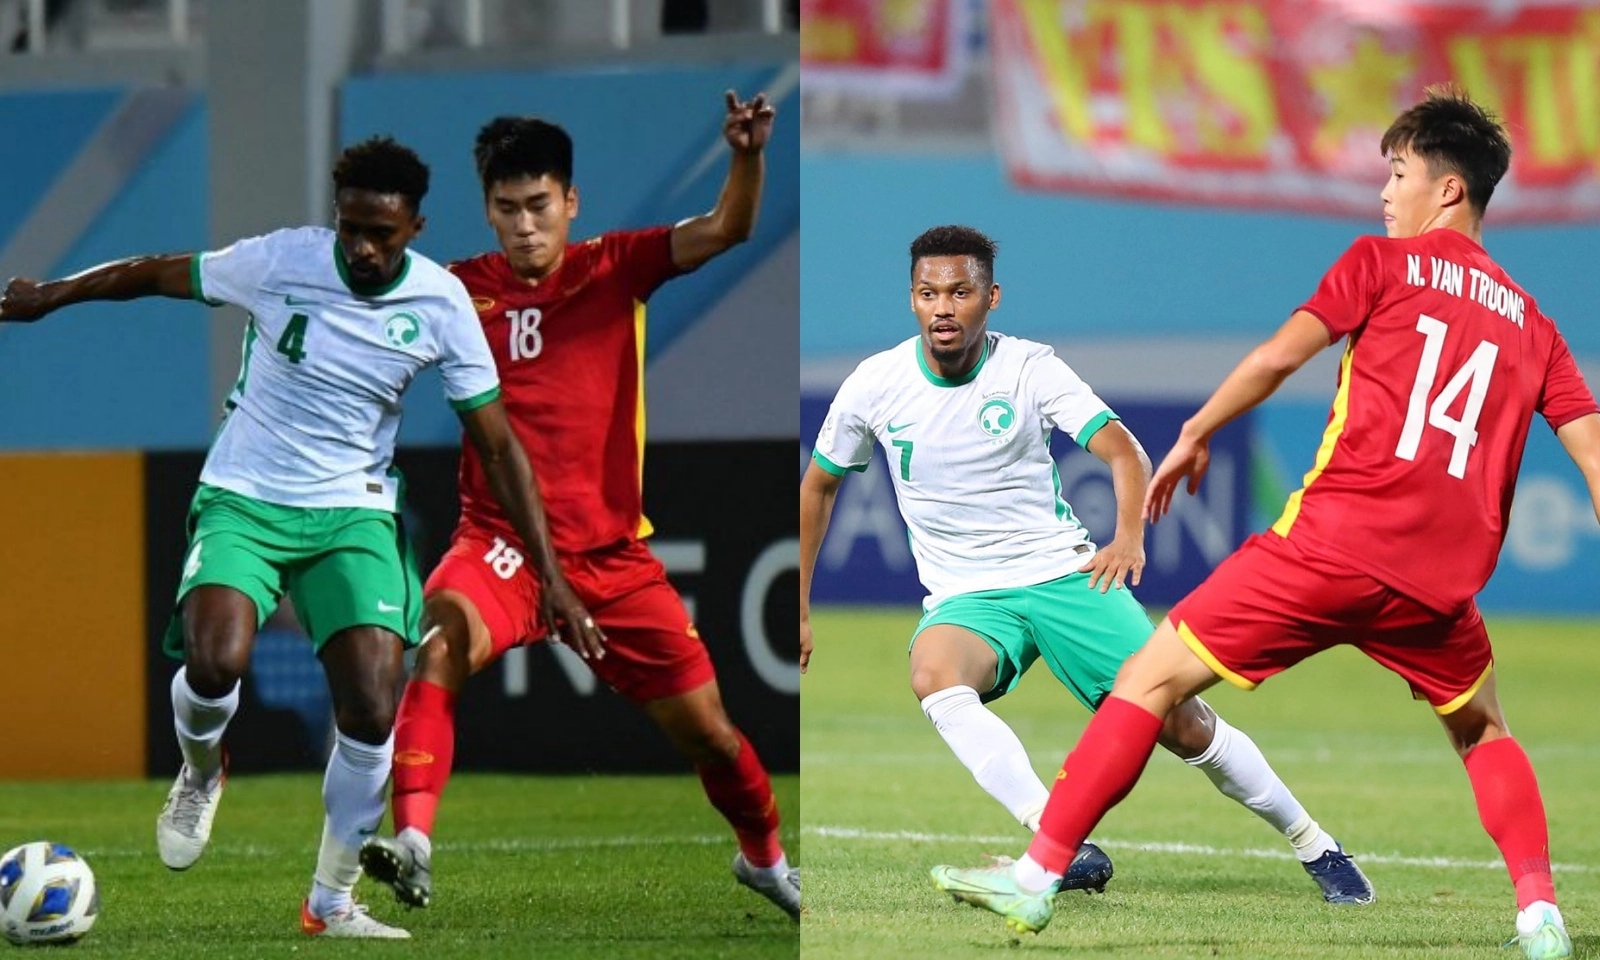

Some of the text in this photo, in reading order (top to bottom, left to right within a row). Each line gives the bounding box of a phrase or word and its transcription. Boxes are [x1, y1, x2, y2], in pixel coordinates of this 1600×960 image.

[1406, 253, 1526, 331] N. VAN TRUONG
[277, 312, 309, 364] 4
[505, 307, 543, 362] 18
[1394, 313, 1500, 480] 14
[891, 439, 914, 482] 7
[483, 536, 525, 580] 18
